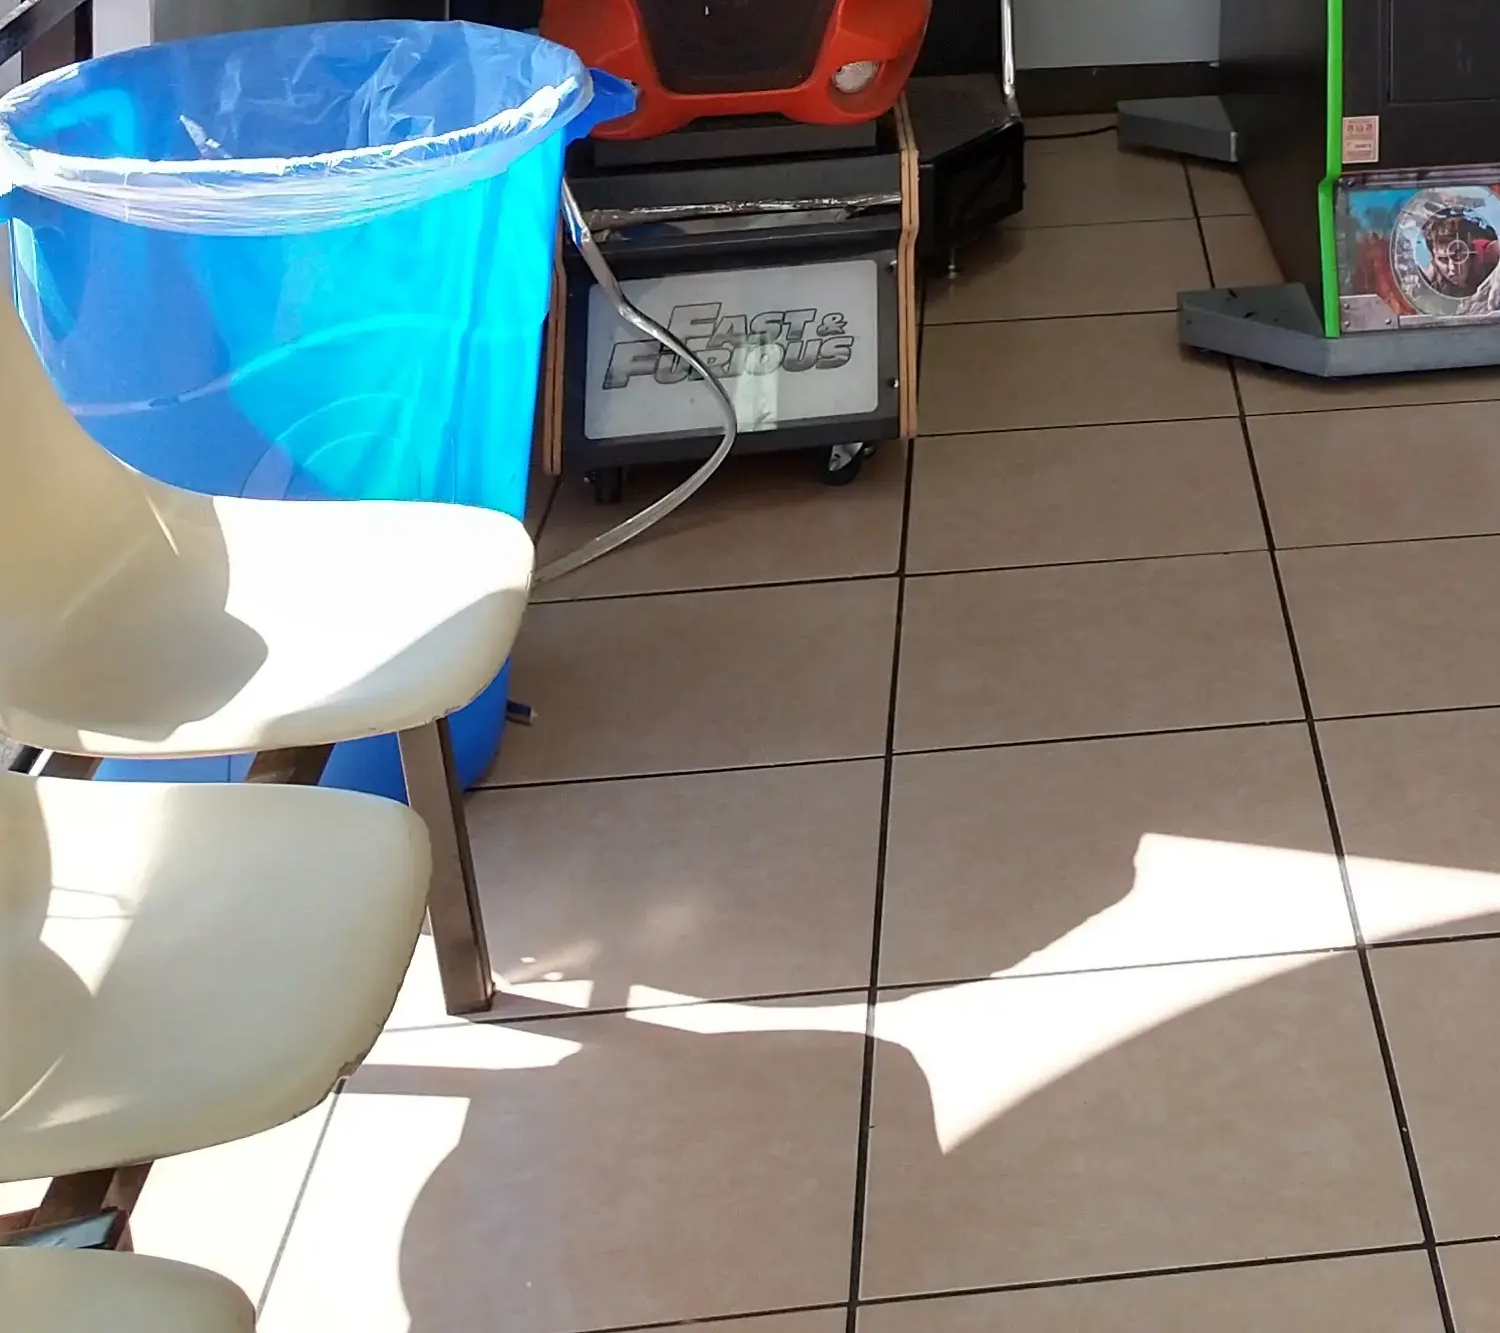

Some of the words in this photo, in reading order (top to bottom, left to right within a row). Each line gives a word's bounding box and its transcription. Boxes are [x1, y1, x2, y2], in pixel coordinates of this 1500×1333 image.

[661, 302, 817, 354] FAST
[817, 312, 848, 337] &
[602, 335, 855, 390] FURIOUS
